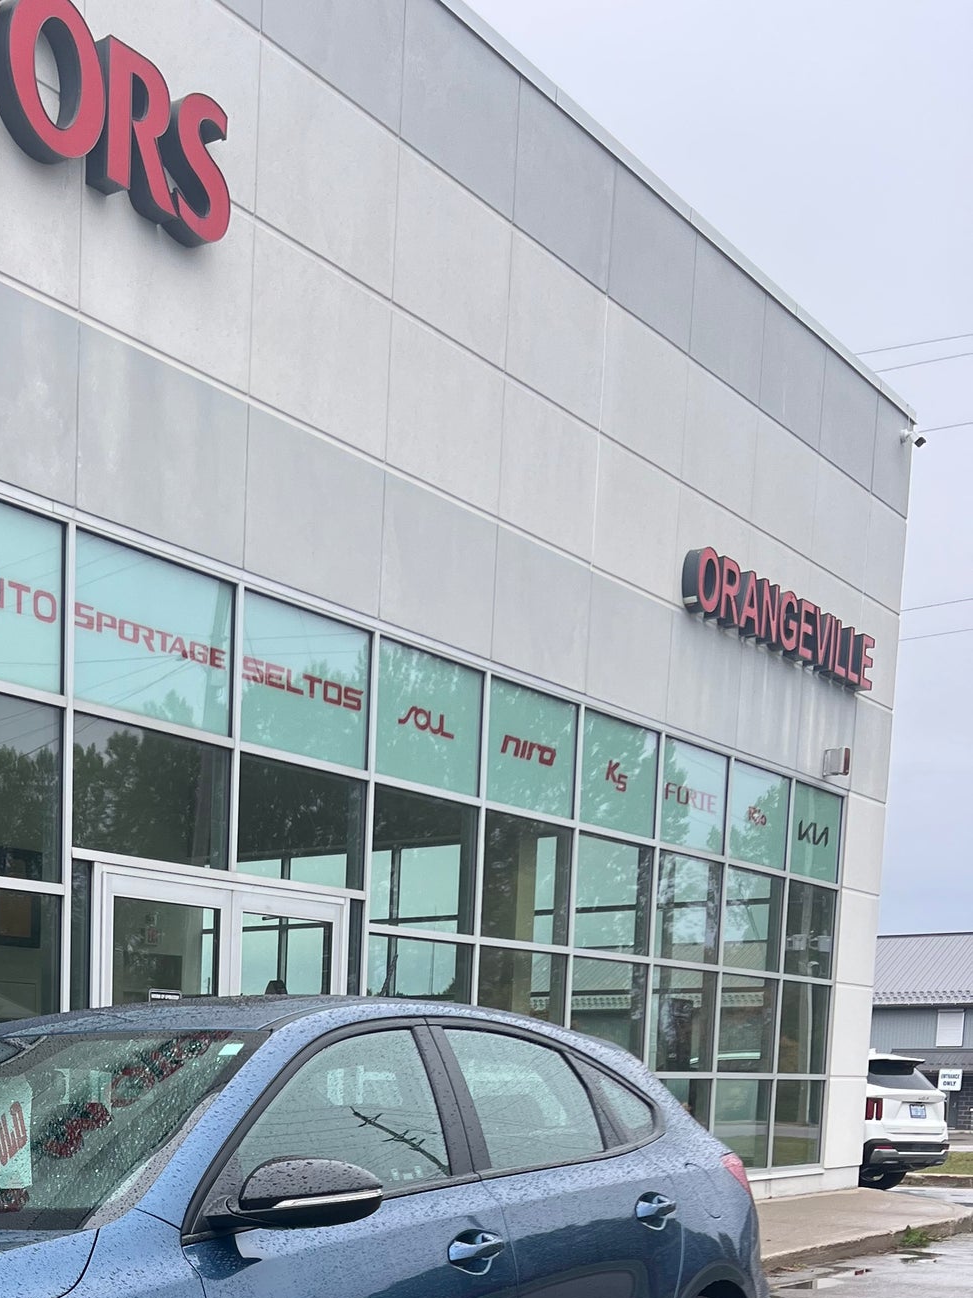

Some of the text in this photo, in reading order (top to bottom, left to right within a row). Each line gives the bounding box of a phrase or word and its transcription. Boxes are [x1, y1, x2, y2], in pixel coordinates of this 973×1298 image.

[74, 602, 227, 671] SPORTAGE
[682, 546, 876, 691] ORANGEVILLE
[242, 656, 364, 712] SELTOS
[605, 760, 628, 792] K5
[665, 782, 718, 814] FORTE
